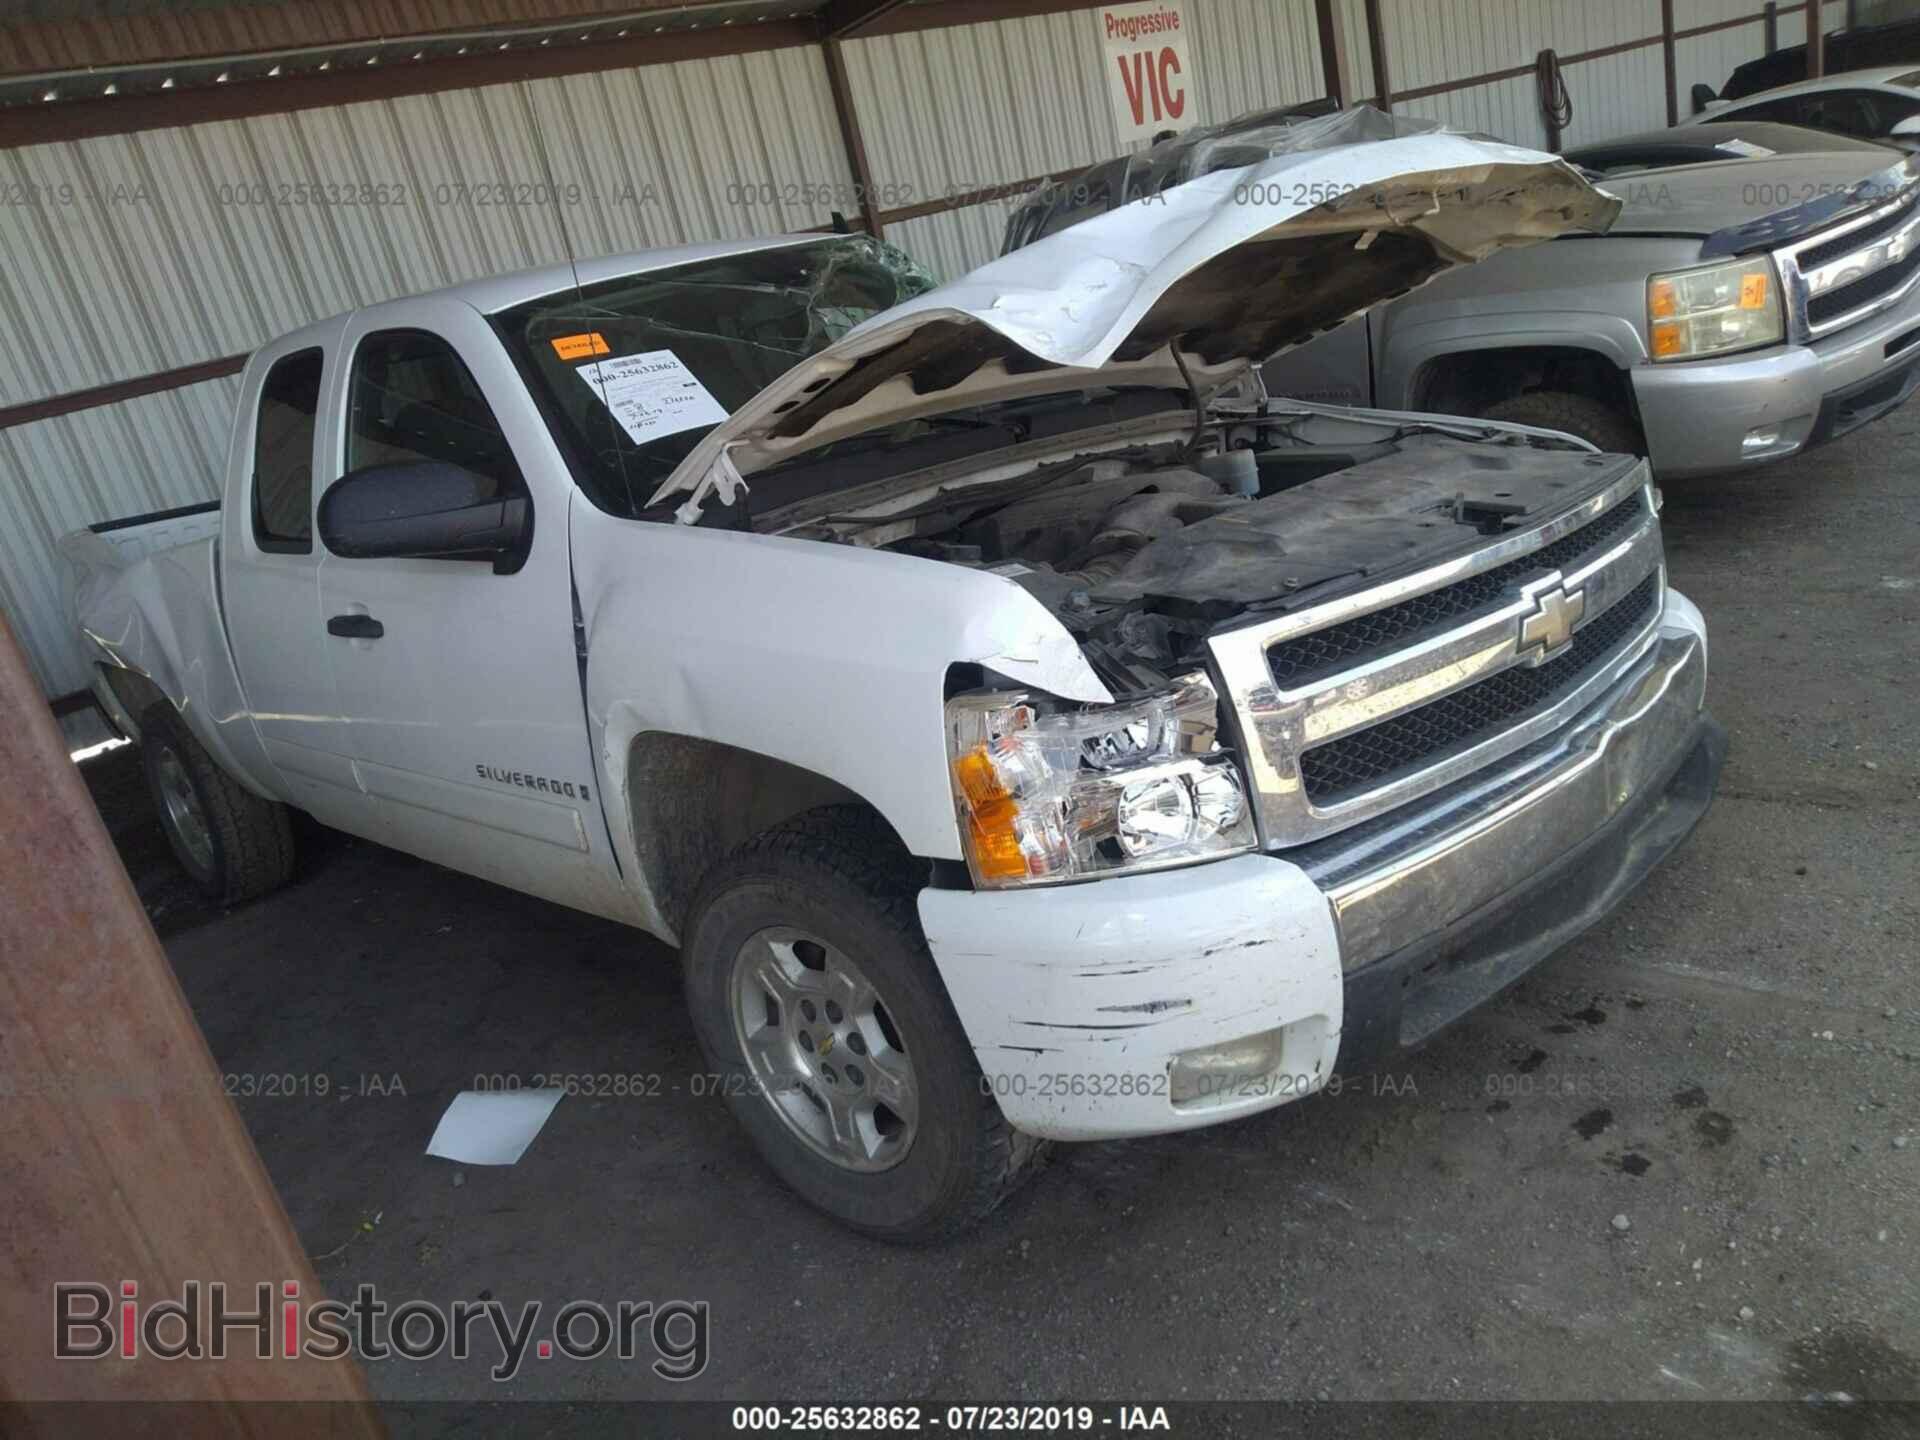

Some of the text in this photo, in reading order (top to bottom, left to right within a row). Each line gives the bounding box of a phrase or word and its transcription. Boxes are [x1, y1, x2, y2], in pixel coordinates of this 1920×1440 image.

[1104, 10, 1180, 41] Progressive
[1117, 46, 1185, 126] VIC
[475, 764, 576, 799] SILVERADO
